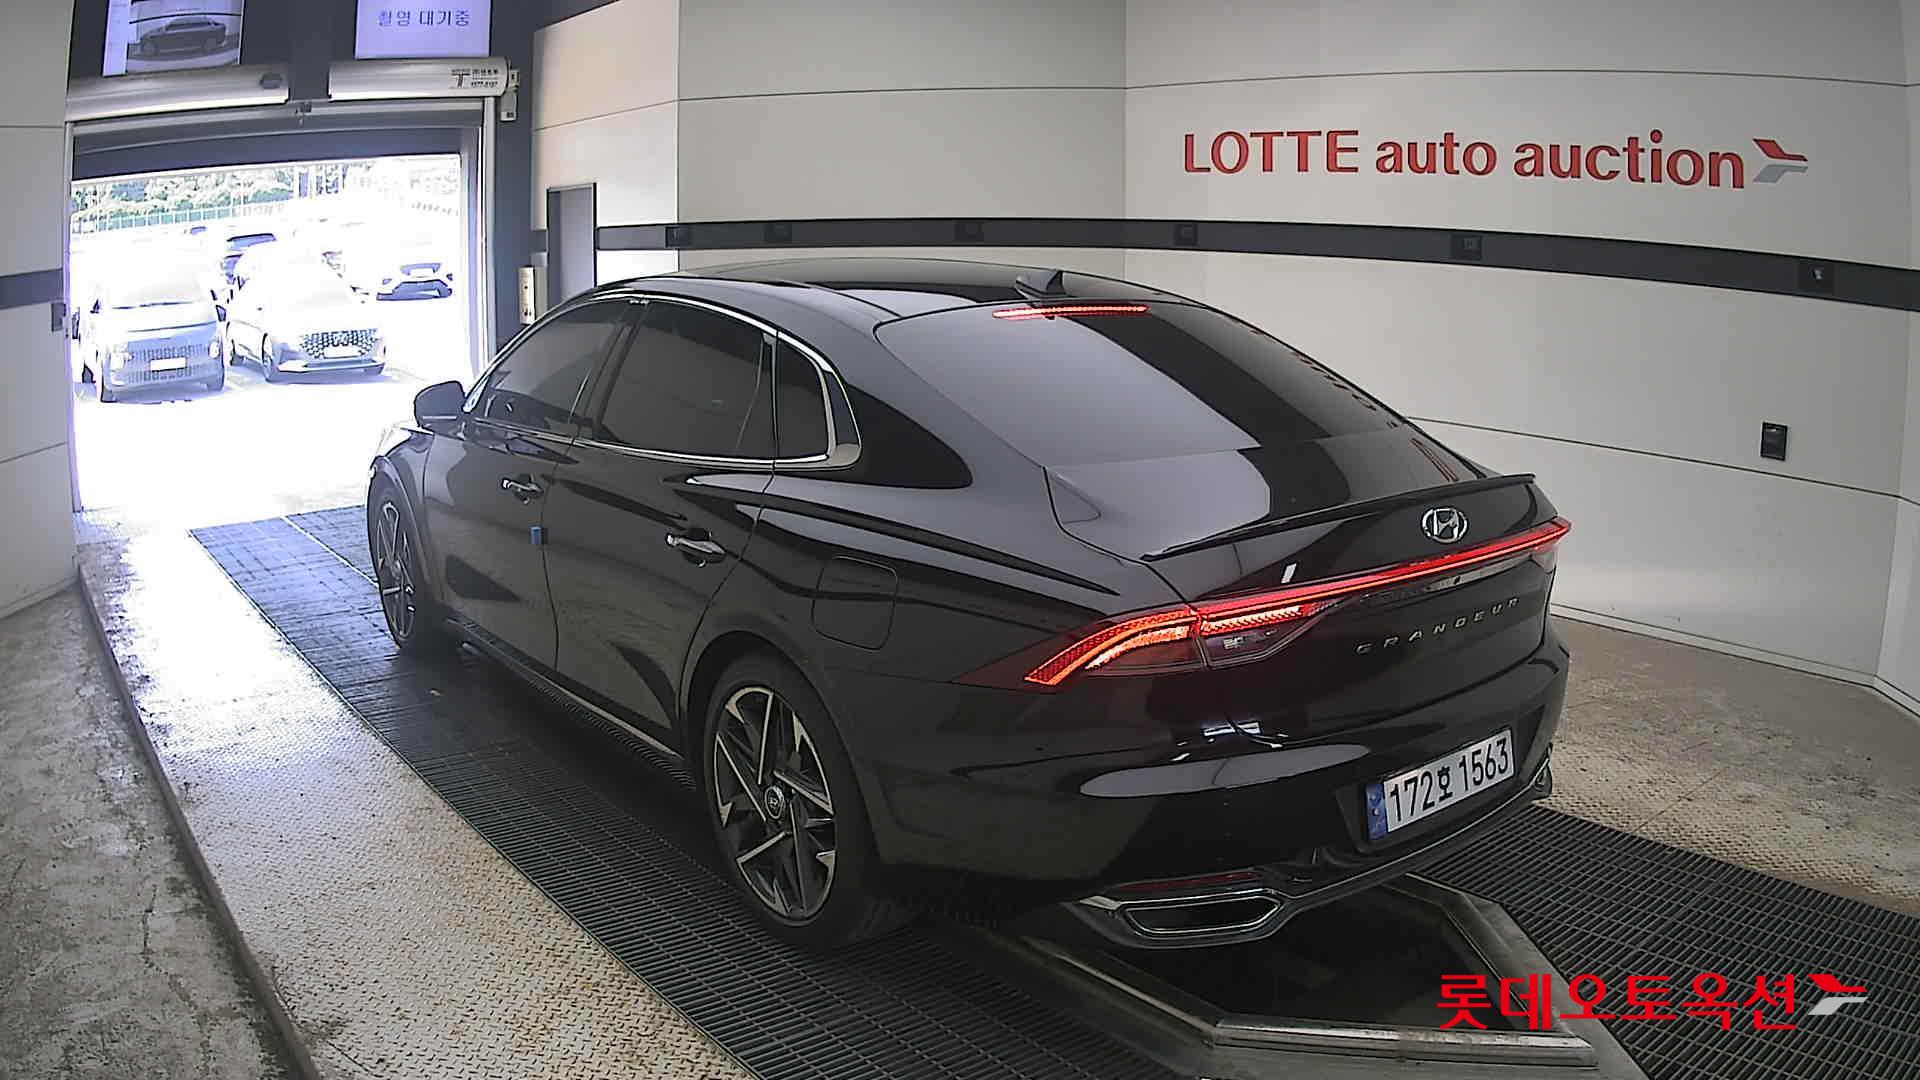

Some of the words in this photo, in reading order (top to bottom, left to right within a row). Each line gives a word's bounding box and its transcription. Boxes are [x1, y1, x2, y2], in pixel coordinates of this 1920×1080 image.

[419, 9, 470, 27] 대기중
[1184, 129, 1360, 175] LOTTE
[1376, 132, 1498, 176] auto
[1513, 130, 1745, 190] auction
[1356, 597, 1519, 655] GRANDEUR
[1458, 737, 1509, 792] 1563
